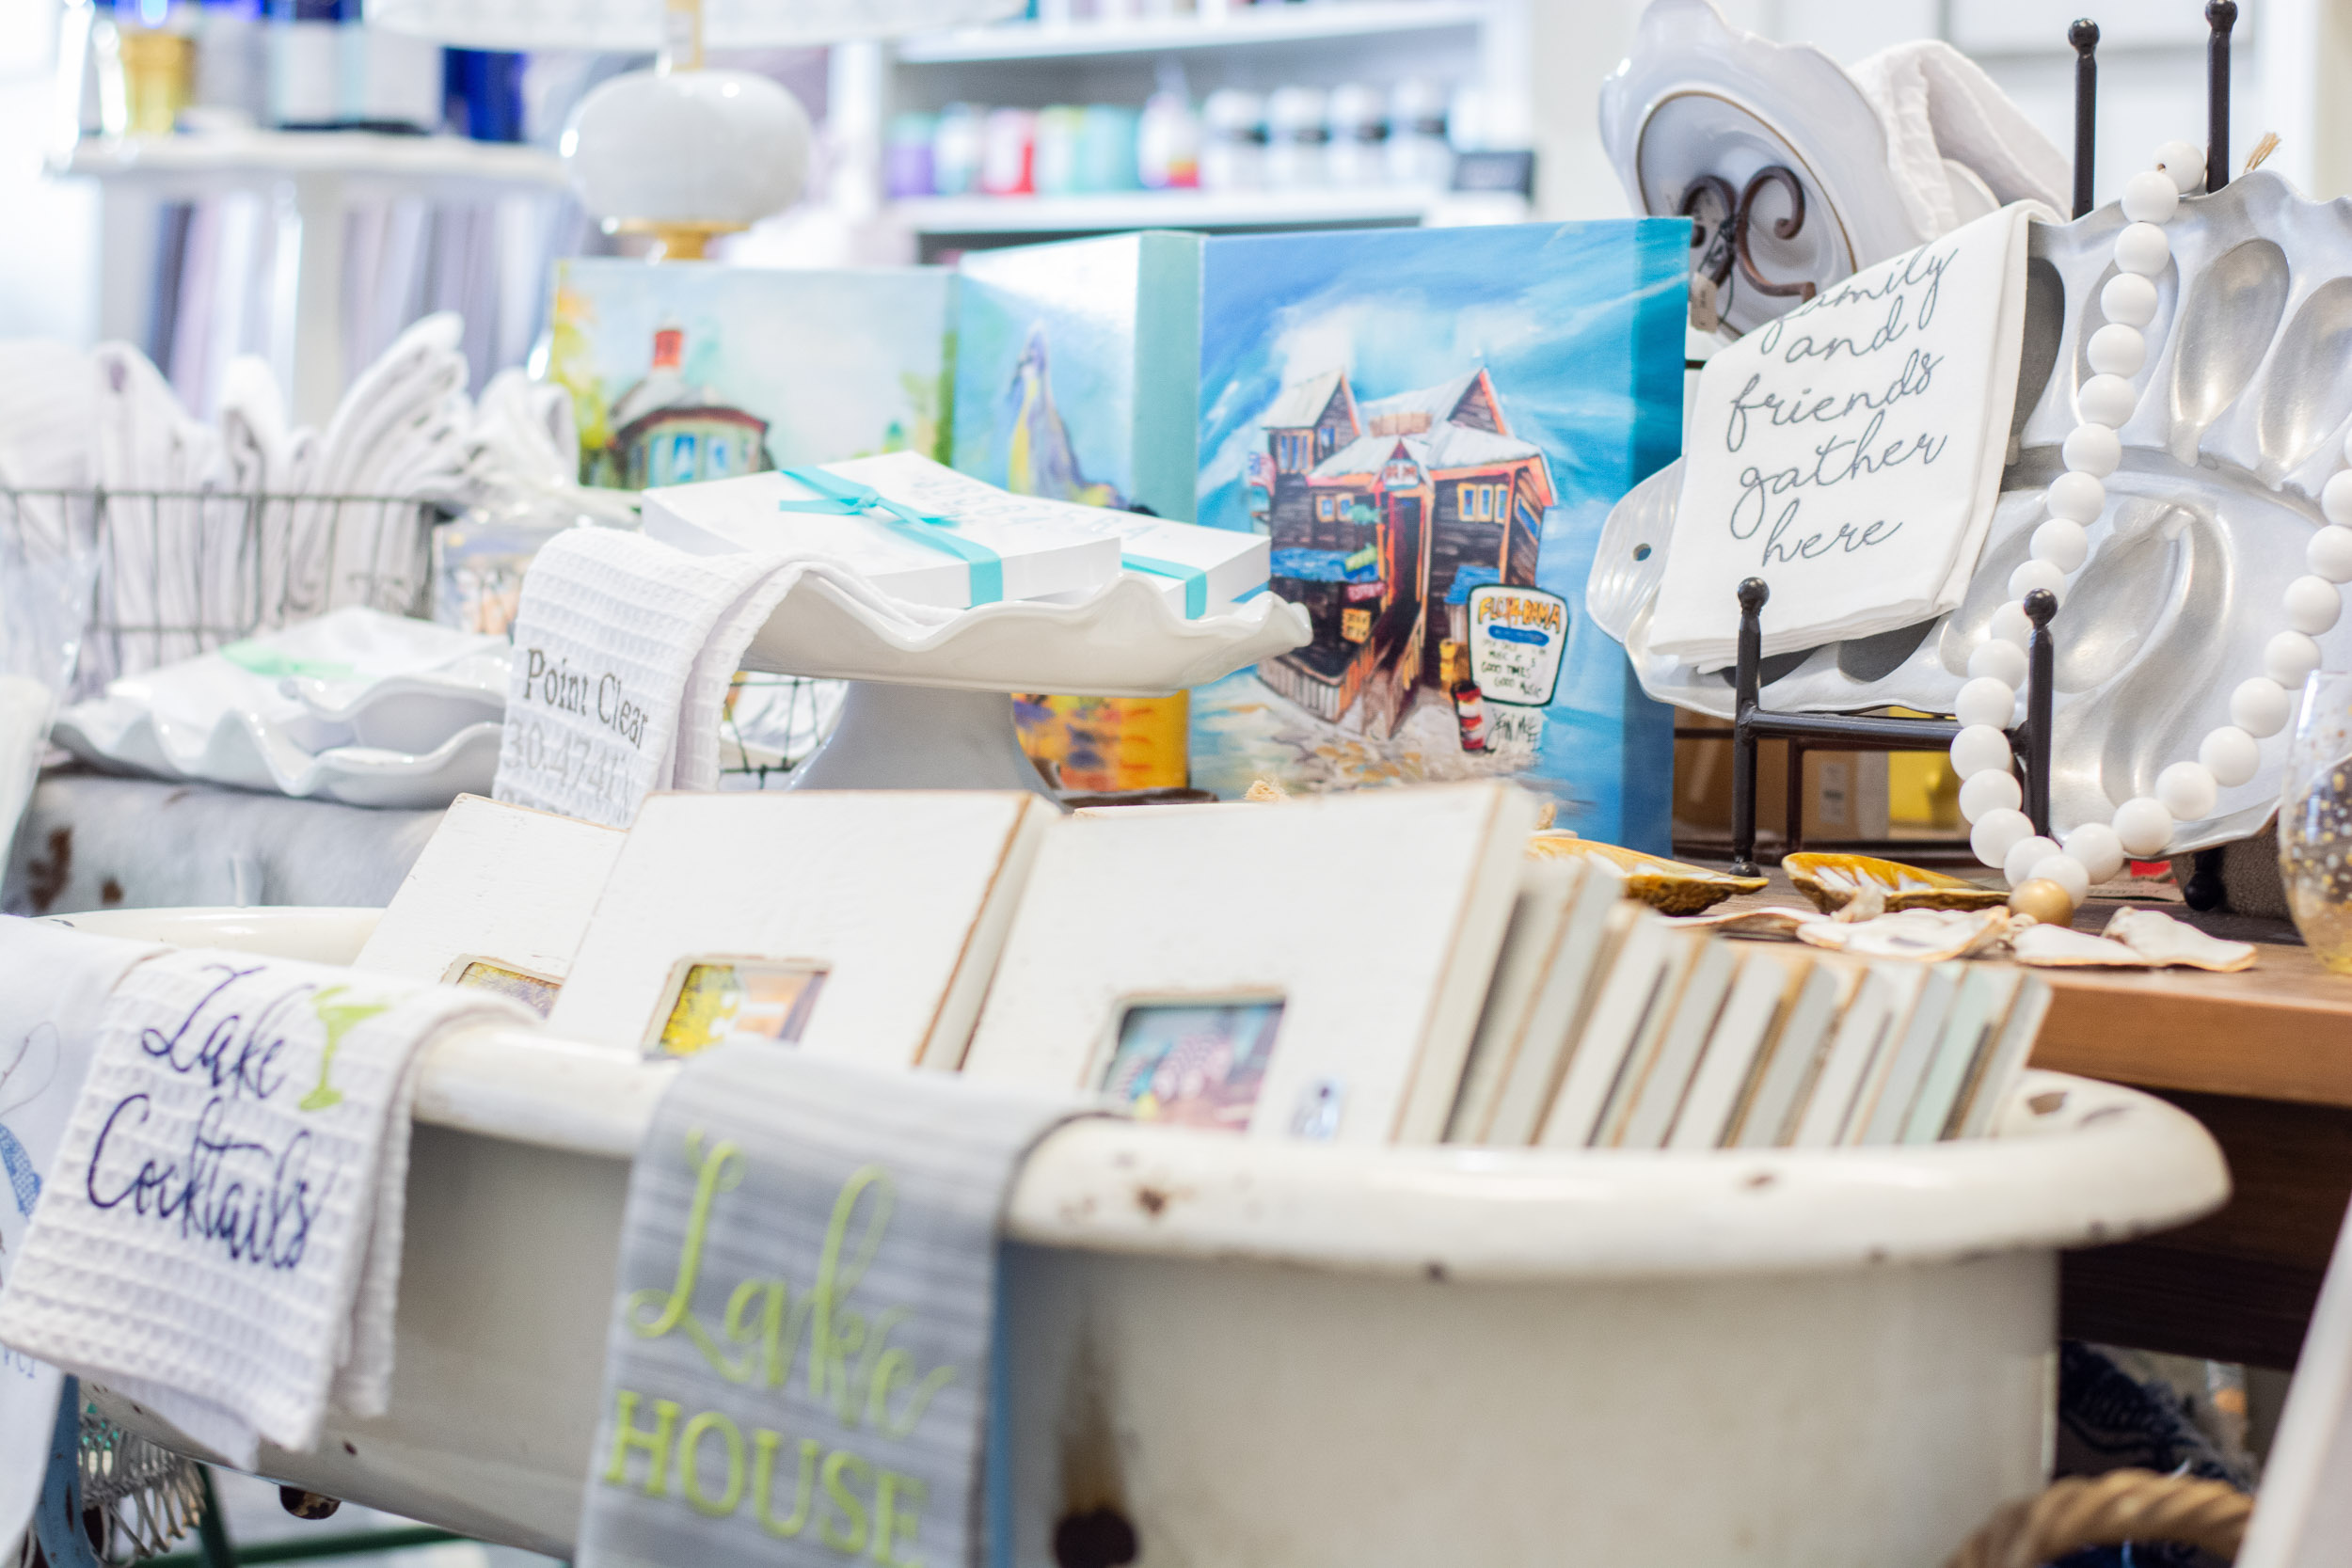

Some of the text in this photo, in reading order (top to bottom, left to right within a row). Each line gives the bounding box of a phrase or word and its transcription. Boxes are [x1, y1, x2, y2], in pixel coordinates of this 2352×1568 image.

[1785, 295, 1909, 363] and
[1726, 349, 1945, 452] friends
[1730, 409, 1947, 540] gather
[1762, 499, 1903, 567] here
[523, 648, 648, 750] Point Clear
[141, 964, 316, 1100] Lake
[87, 1093, 340, 1270] Cocktails
[627, 1128, 959, 1441] Lake
[602, 1388, 930, 1568] HOUSE
